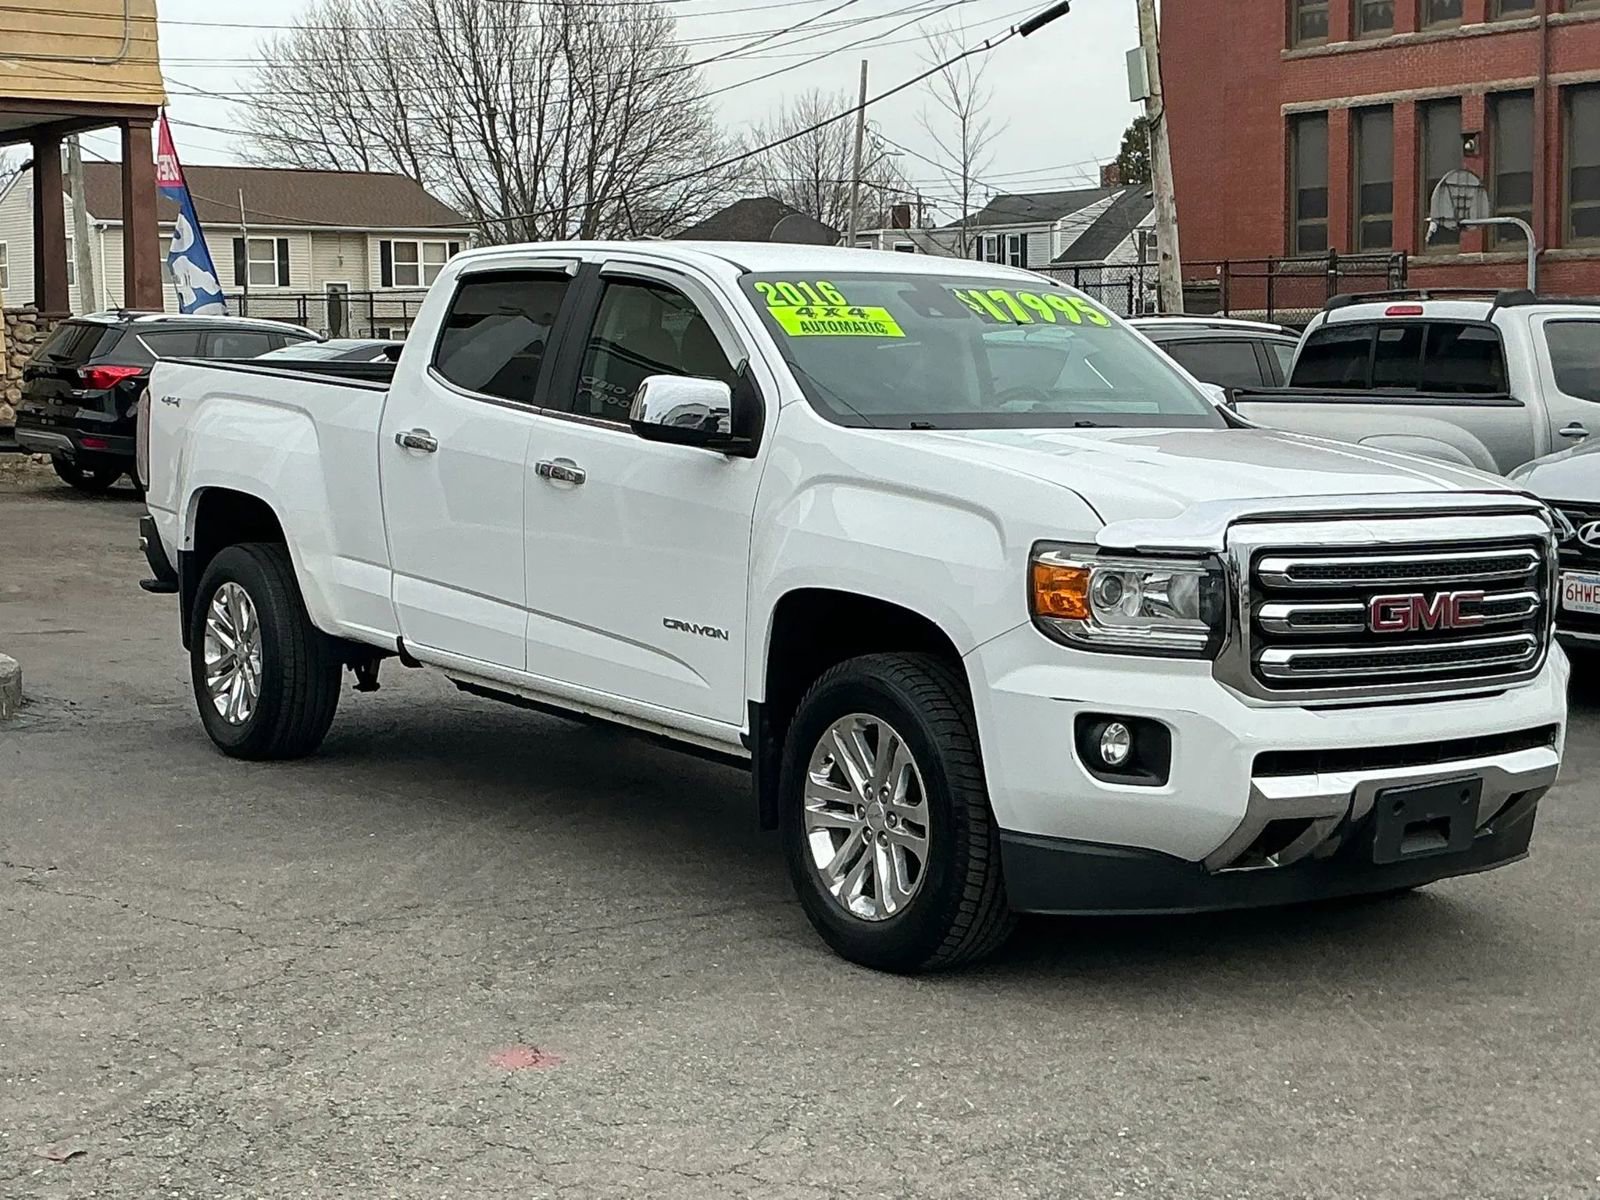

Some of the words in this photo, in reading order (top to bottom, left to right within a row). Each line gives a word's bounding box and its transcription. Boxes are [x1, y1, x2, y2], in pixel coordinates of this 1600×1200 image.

[753, 280, 848, 306] 2016
[952, 288, 1112, 328] $17995
[800, 320, 888, 334] AUTOMATIC
[1370, 590, 1484, 633] GMC
[662, 617, 729, 641] CANYON
